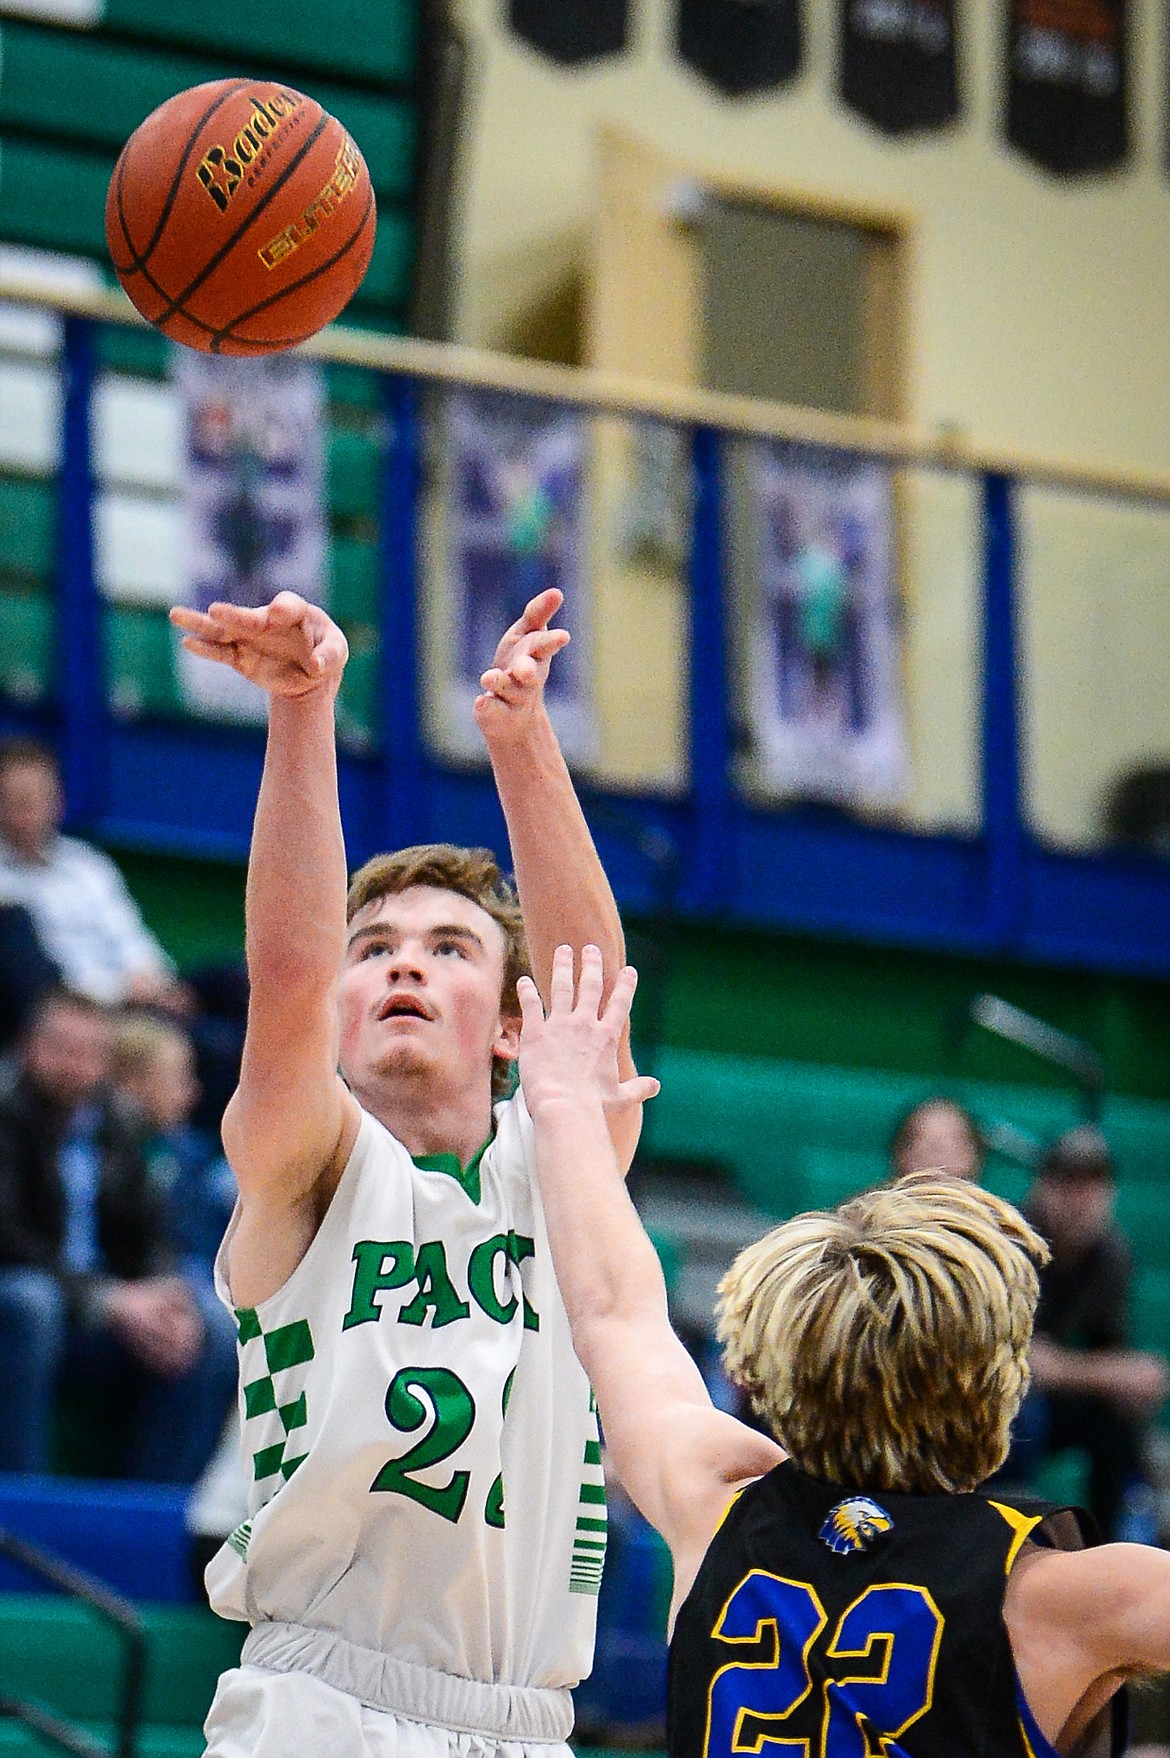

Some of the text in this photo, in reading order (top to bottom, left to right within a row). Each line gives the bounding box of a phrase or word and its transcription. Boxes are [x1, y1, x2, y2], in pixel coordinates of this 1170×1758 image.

[197, 87, 304, 213] Baden
[369, 1364, 517, 1530] 2
[702, 1568, 946, 1758] 22
